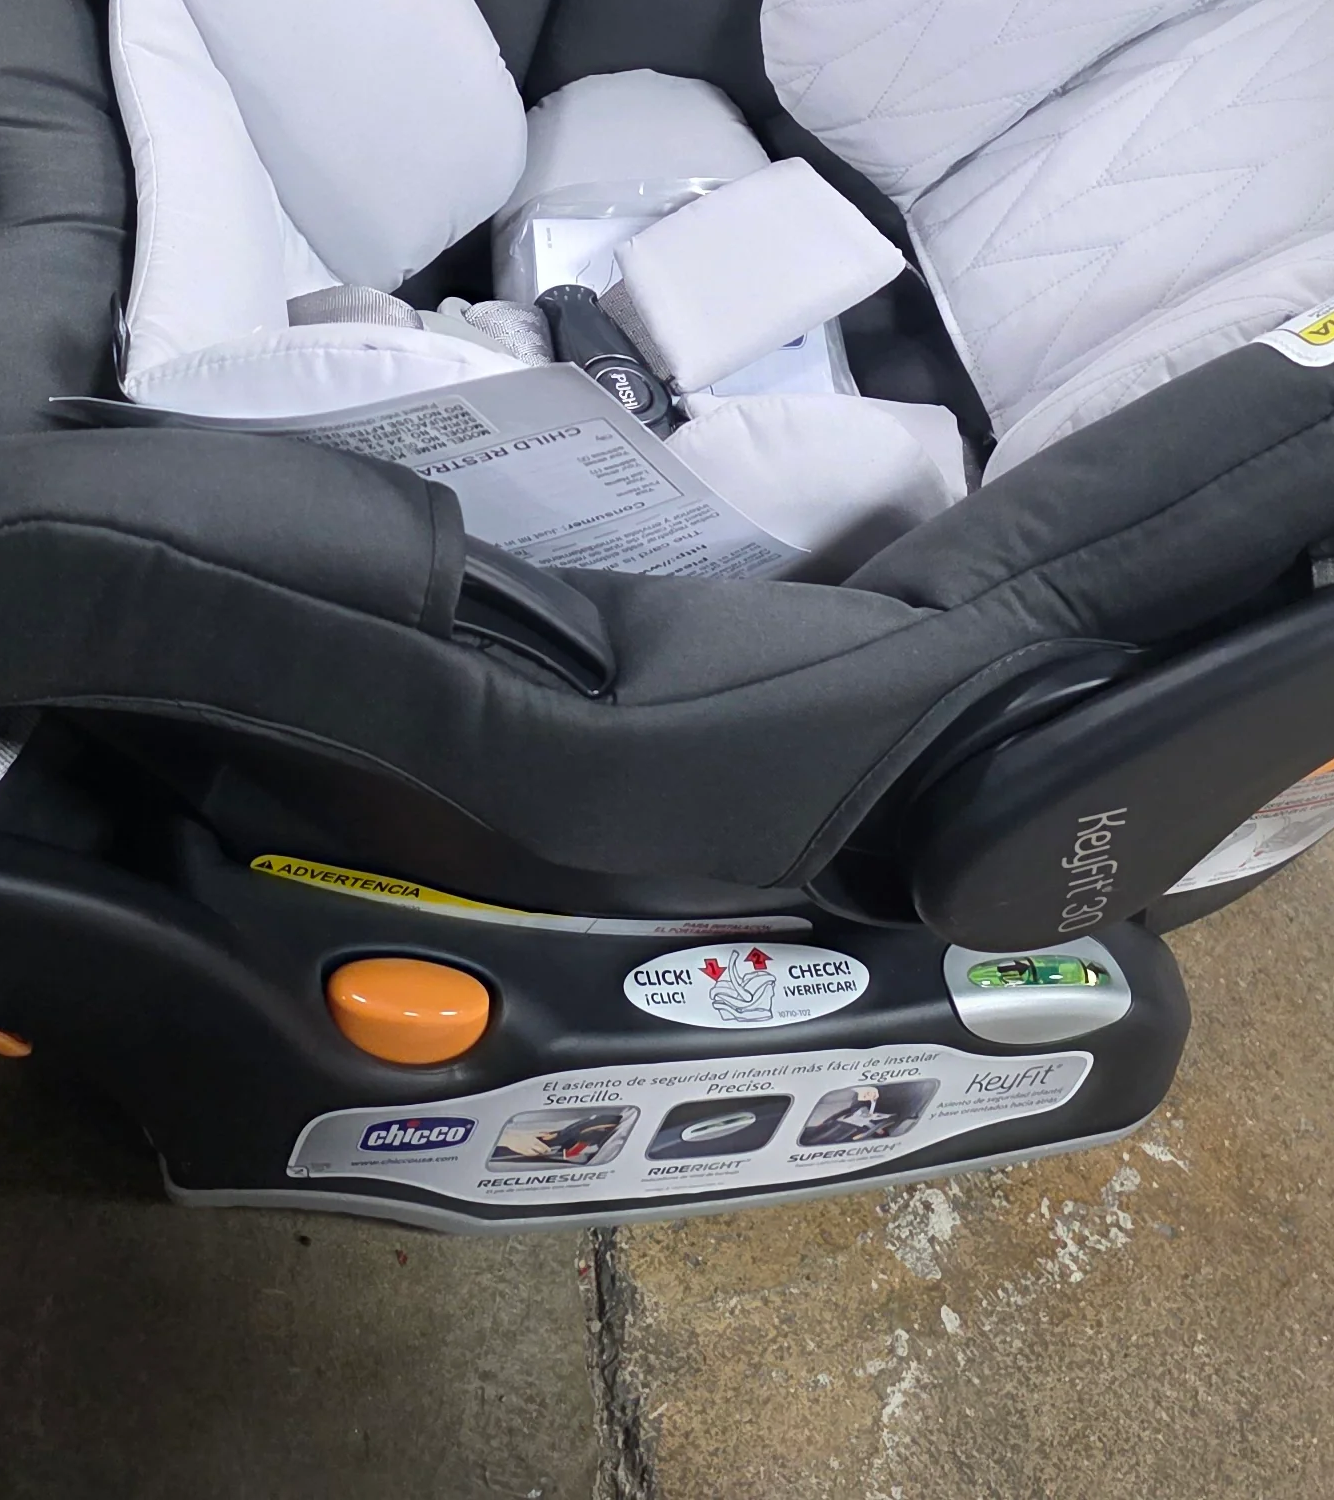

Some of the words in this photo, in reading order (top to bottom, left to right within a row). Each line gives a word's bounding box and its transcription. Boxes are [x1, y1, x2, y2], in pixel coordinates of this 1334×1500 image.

[609, 372, 639, 411] PUSH
[513, 427, 581, 450] CHILD
[416, 447, 508, 478] RESTRA
[277, 863, 421, 899] ADVERTENCIA
[633, 969, 693, 988] CLICK!
[788, 959, 852, 980] CHECK!
[644, 991, 686, 1006] ¡CLIC!
[782, 980, 858, 998] ¡VERIFICAR!
[542, 1081, 559, 1093] El
[561, 1076, 622, 1092] asiento
[627, 1074, 647, 1088] de
[652, 1069, 729, 1088] seguridad
[731, 1064, 789, 1080] infantil
[791, 1061, 824, 1076] más
[826, 1058, 860, 1073] fácil
[862, 1055, 881, 1069] de
[883, 1051, 941, 1067] instalar
[858, 1067, 922, 1084] Seguro.
[543, 1090, 624, 1107] Sencillo.
[706, 1080, 776, 1096] Preciso.
[367, 1122, 467, 1148] chicco
